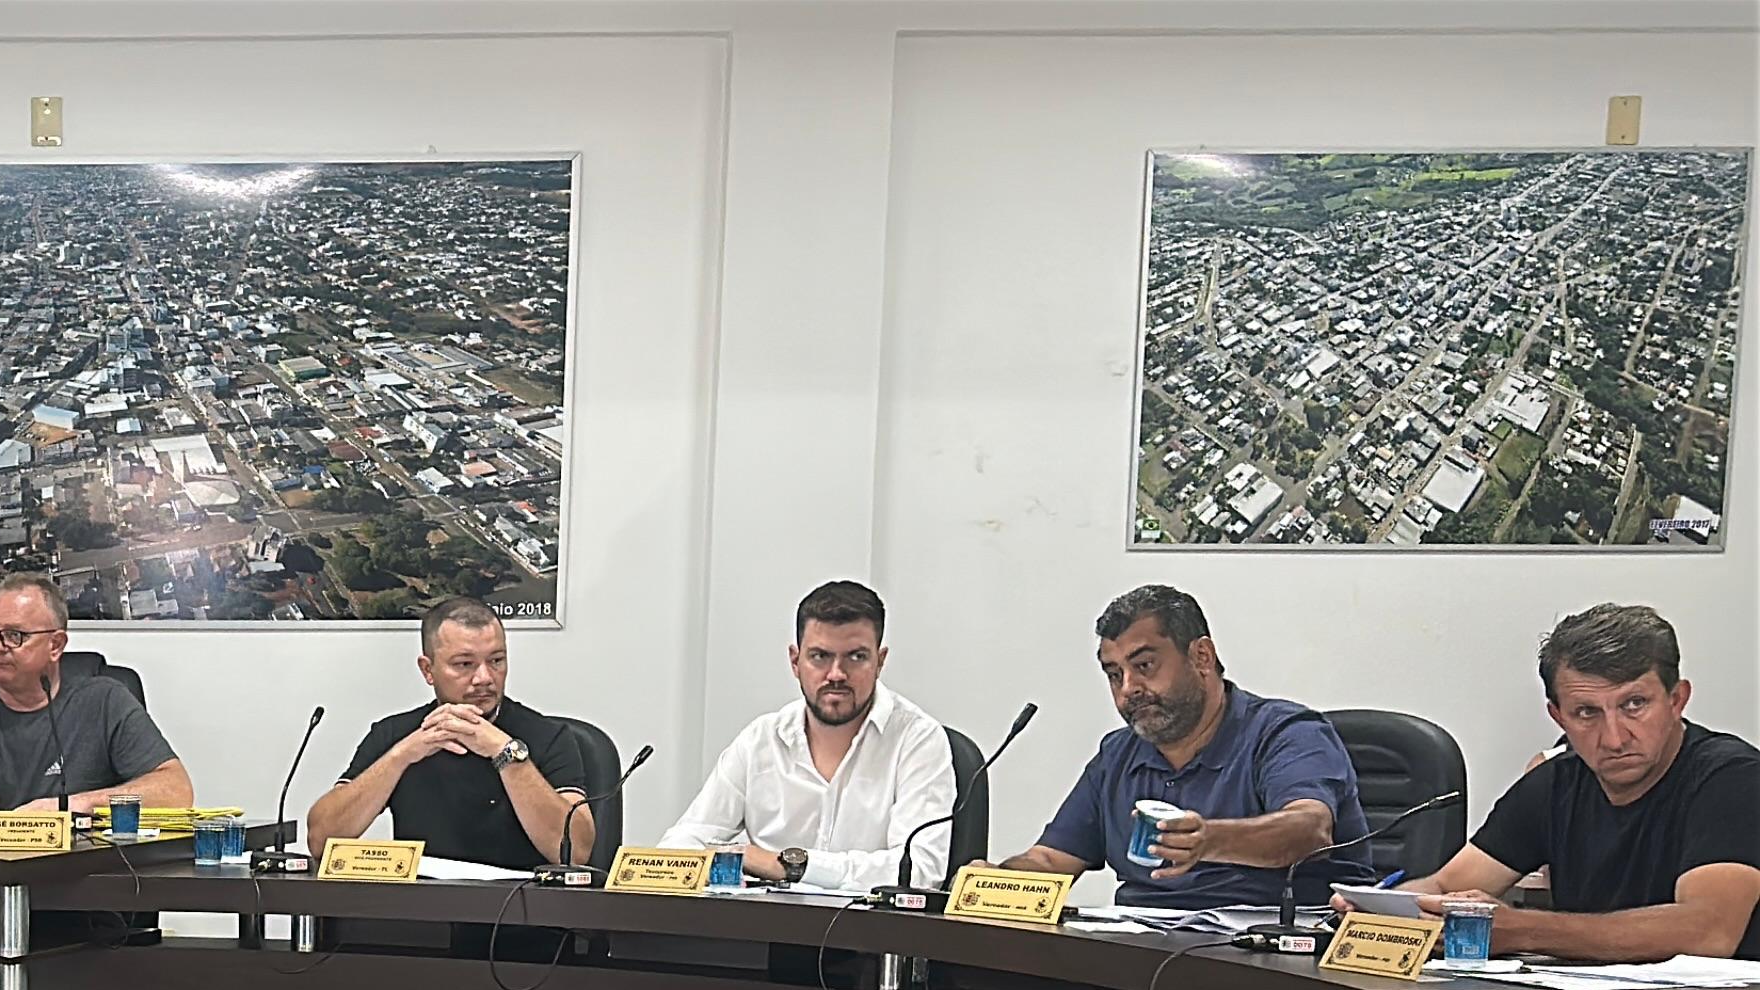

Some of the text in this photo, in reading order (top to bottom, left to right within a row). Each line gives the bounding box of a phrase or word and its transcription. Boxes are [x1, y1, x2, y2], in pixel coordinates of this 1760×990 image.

[517, 602, 551, 615] 2018
[361, 849, 388, 857] TASSO
[628, 858, 699, 868] RENAN VANIN
[975, 881, 1051, 894] LEANDRO HAHN
[1375, 934, 1423, 946] DOMBROSKI
